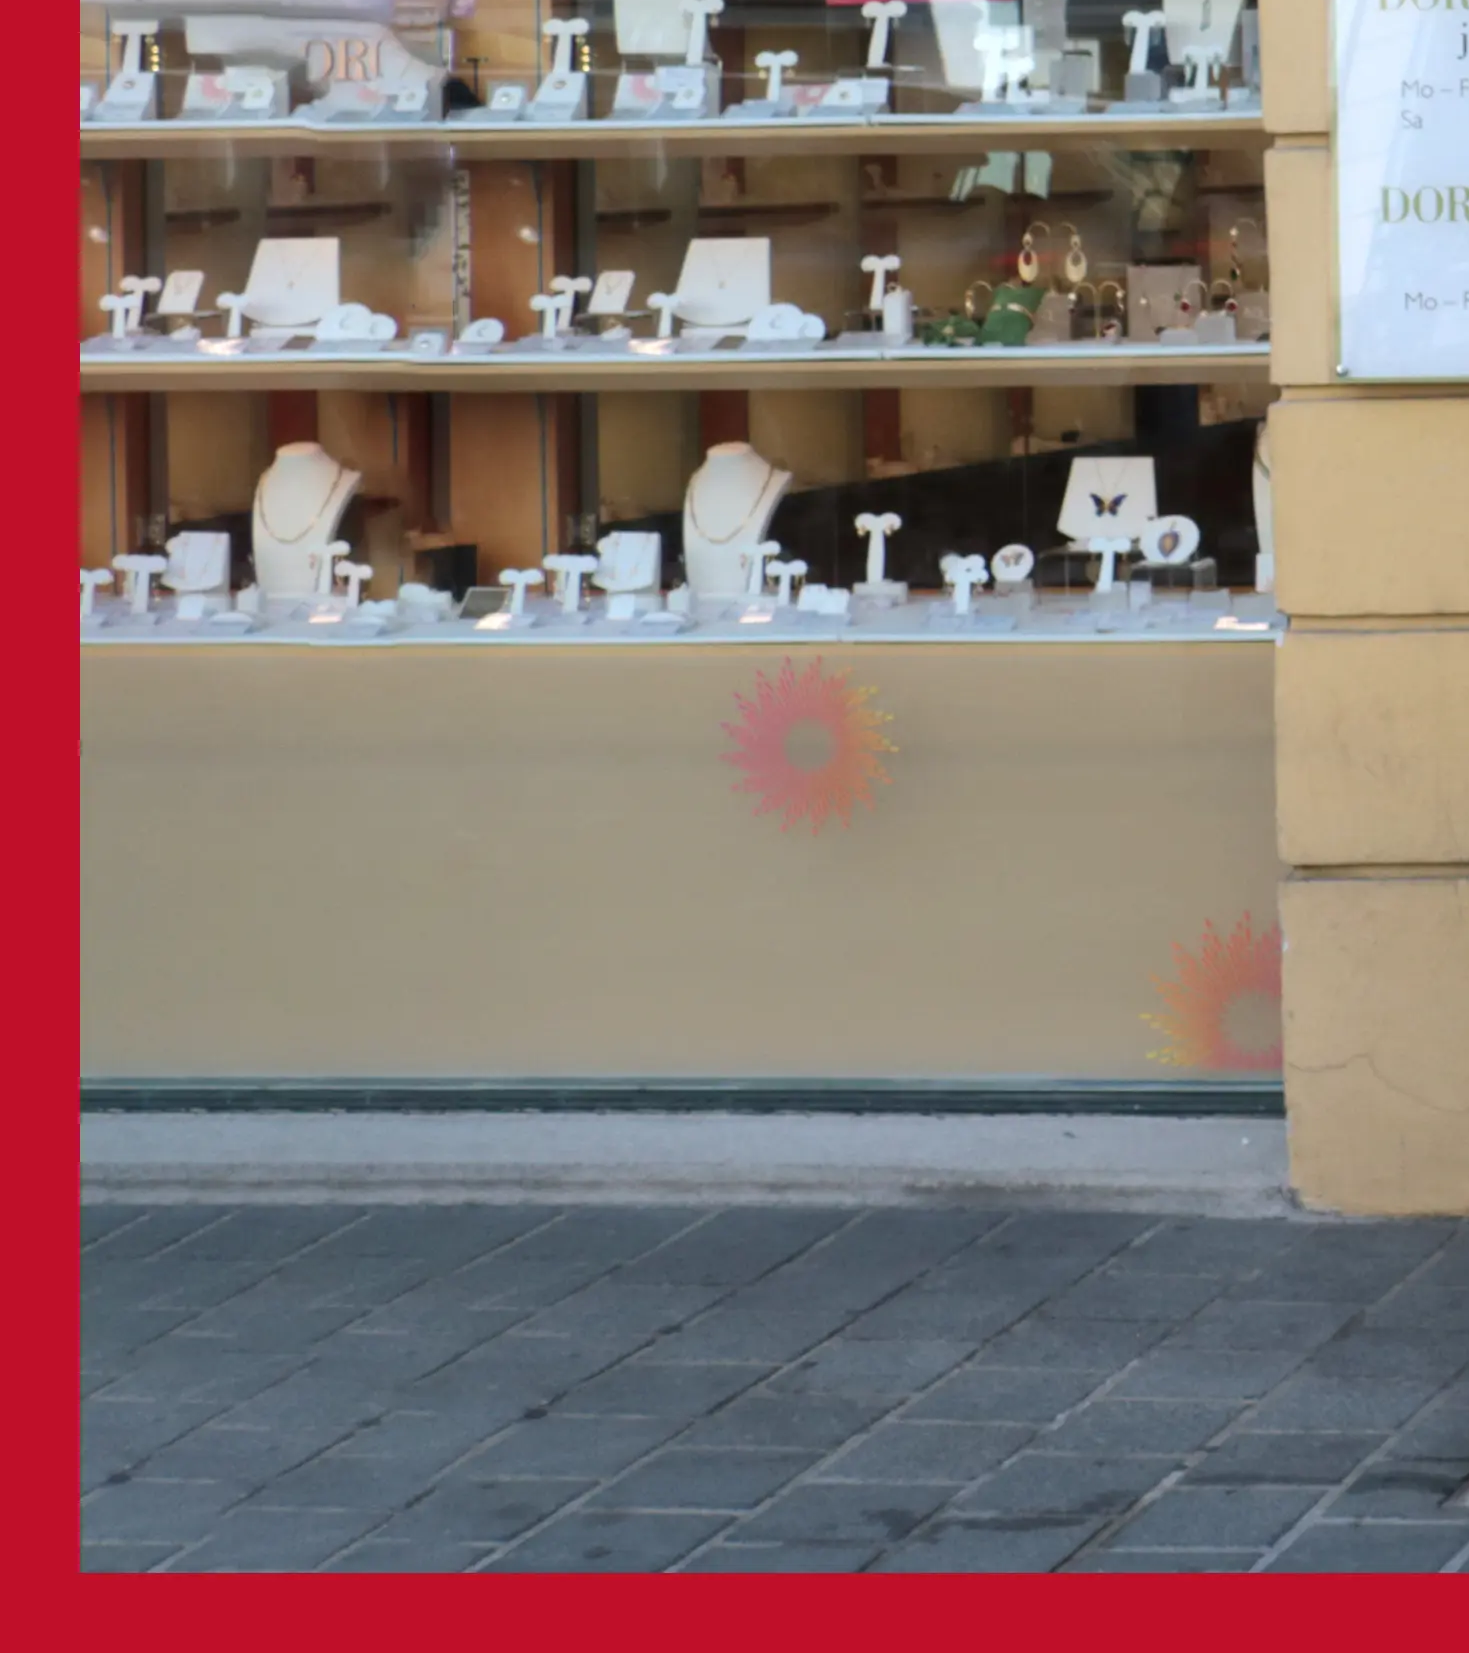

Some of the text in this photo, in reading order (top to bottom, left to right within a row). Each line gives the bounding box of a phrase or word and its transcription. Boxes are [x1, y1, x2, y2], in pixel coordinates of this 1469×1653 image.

[1400, 79, 1434, 99] Mo
[1400, 109, 1423, 129] Sa
[1404, 291, 1438, 311] Mo
